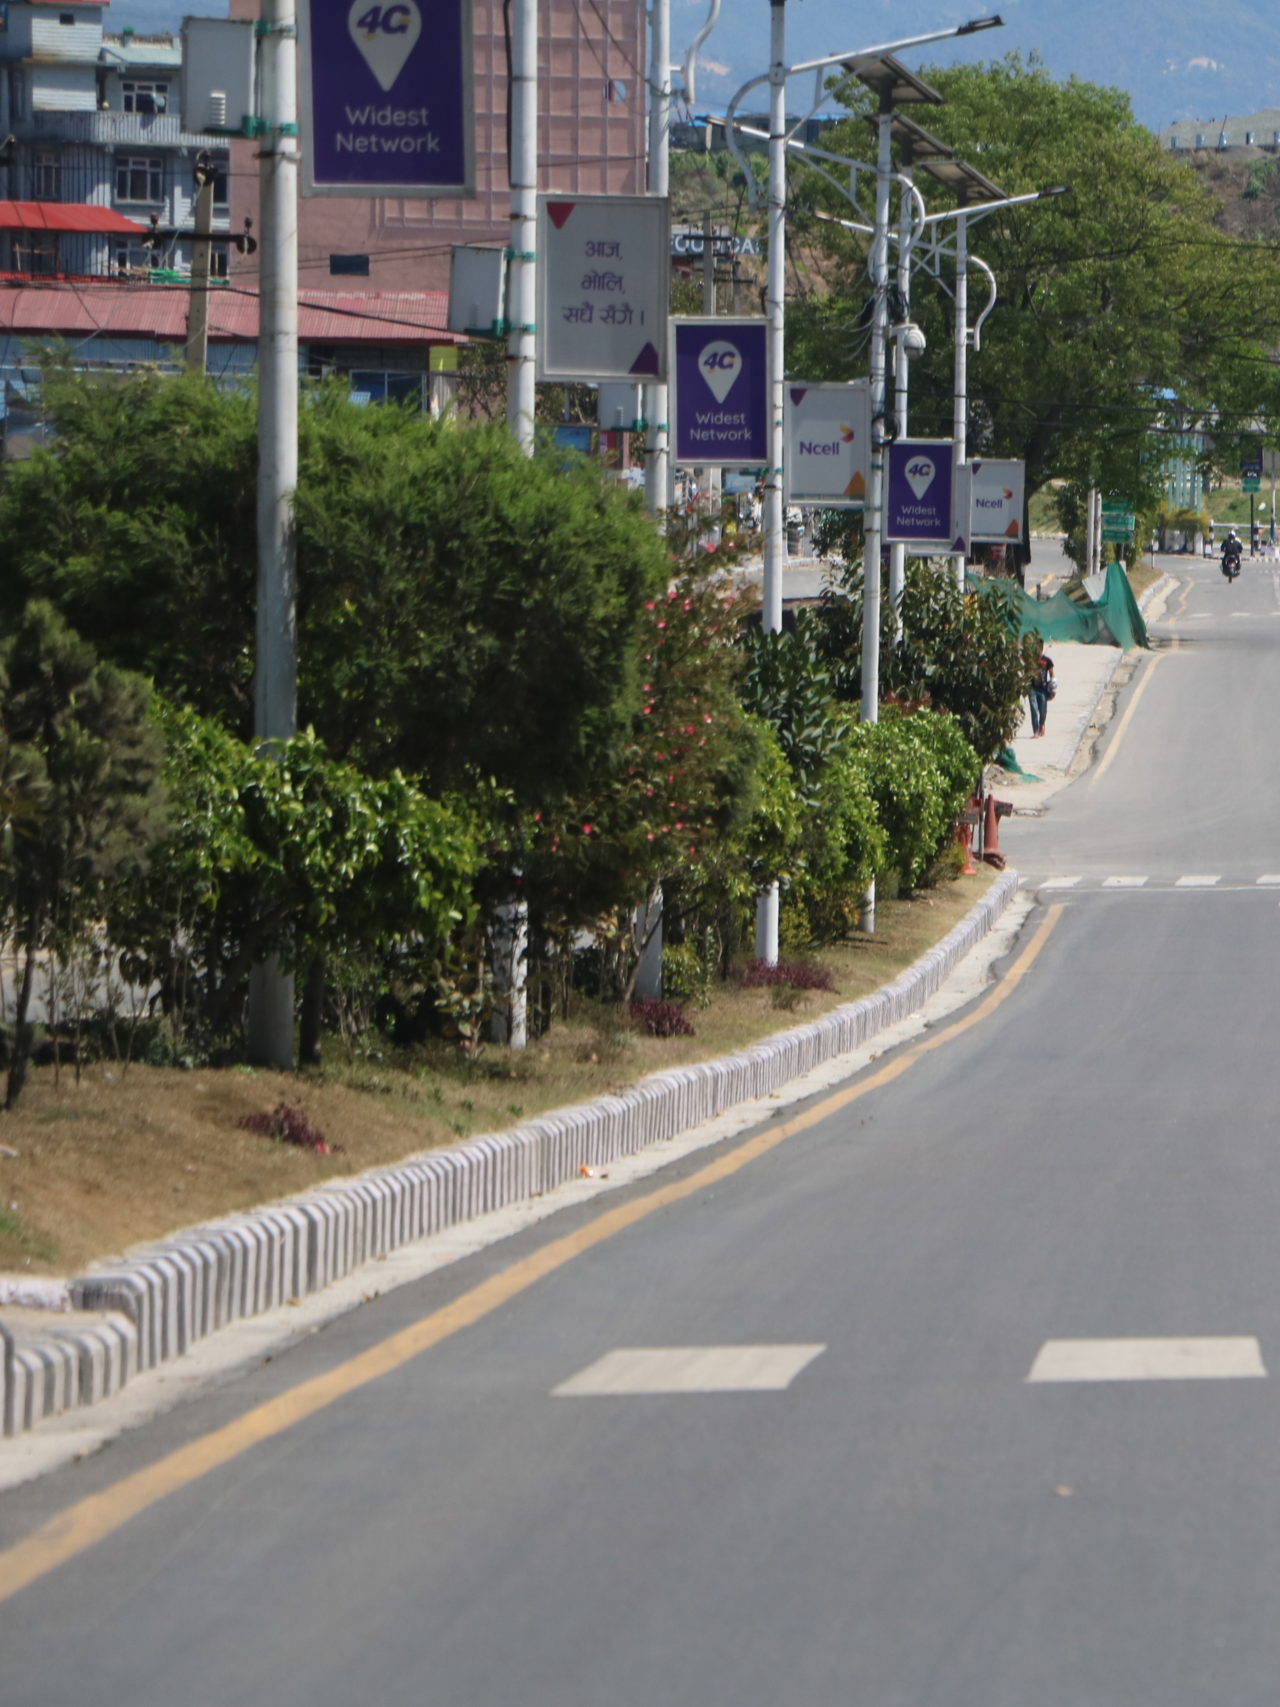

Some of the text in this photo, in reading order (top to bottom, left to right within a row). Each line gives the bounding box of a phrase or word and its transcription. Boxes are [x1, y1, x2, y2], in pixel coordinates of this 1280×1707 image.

[357, 5, 411, 34] 4G
[345, 105, 429, 126] Widest
[336, 132, 440, 152] Network
[585, 240, 623, 261] आज,
[581, 269, 626, 294] भोलि,
[703, 351, 736, 370] 4G
[696, 412, 746, 425] Widest
[690, 428, 752, 441] Network
[799, 441, 840, 455] Ncell
[908, 463, 931, 477] 4G
[901, 505, 936, 516] Widest
[976, 498, 1002, 509] Ncell
[896, 516, 941, 528] Network
